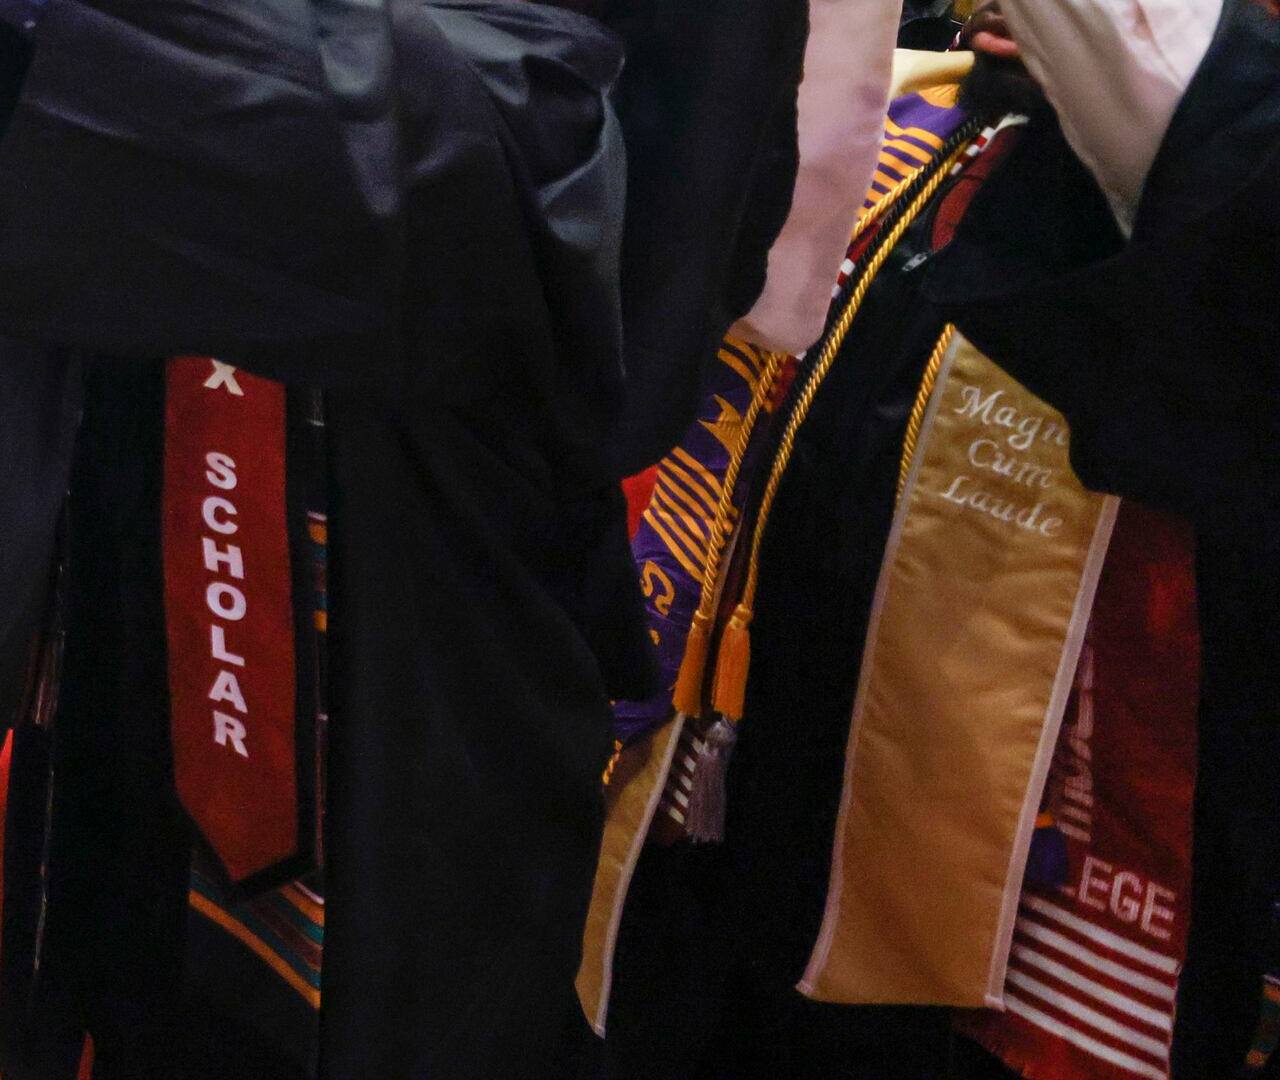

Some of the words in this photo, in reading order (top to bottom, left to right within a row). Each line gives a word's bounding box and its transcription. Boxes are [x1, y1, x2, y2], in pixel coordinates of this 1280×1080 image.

[953, 385, 1067, 450] Magn
[968, 438, 1053, 488] Cum
[940, 475, 1063, 537] Laude
[202, 451, 249, 758] SCHOLAR
[1060, 855, 1177, 941] EGE
